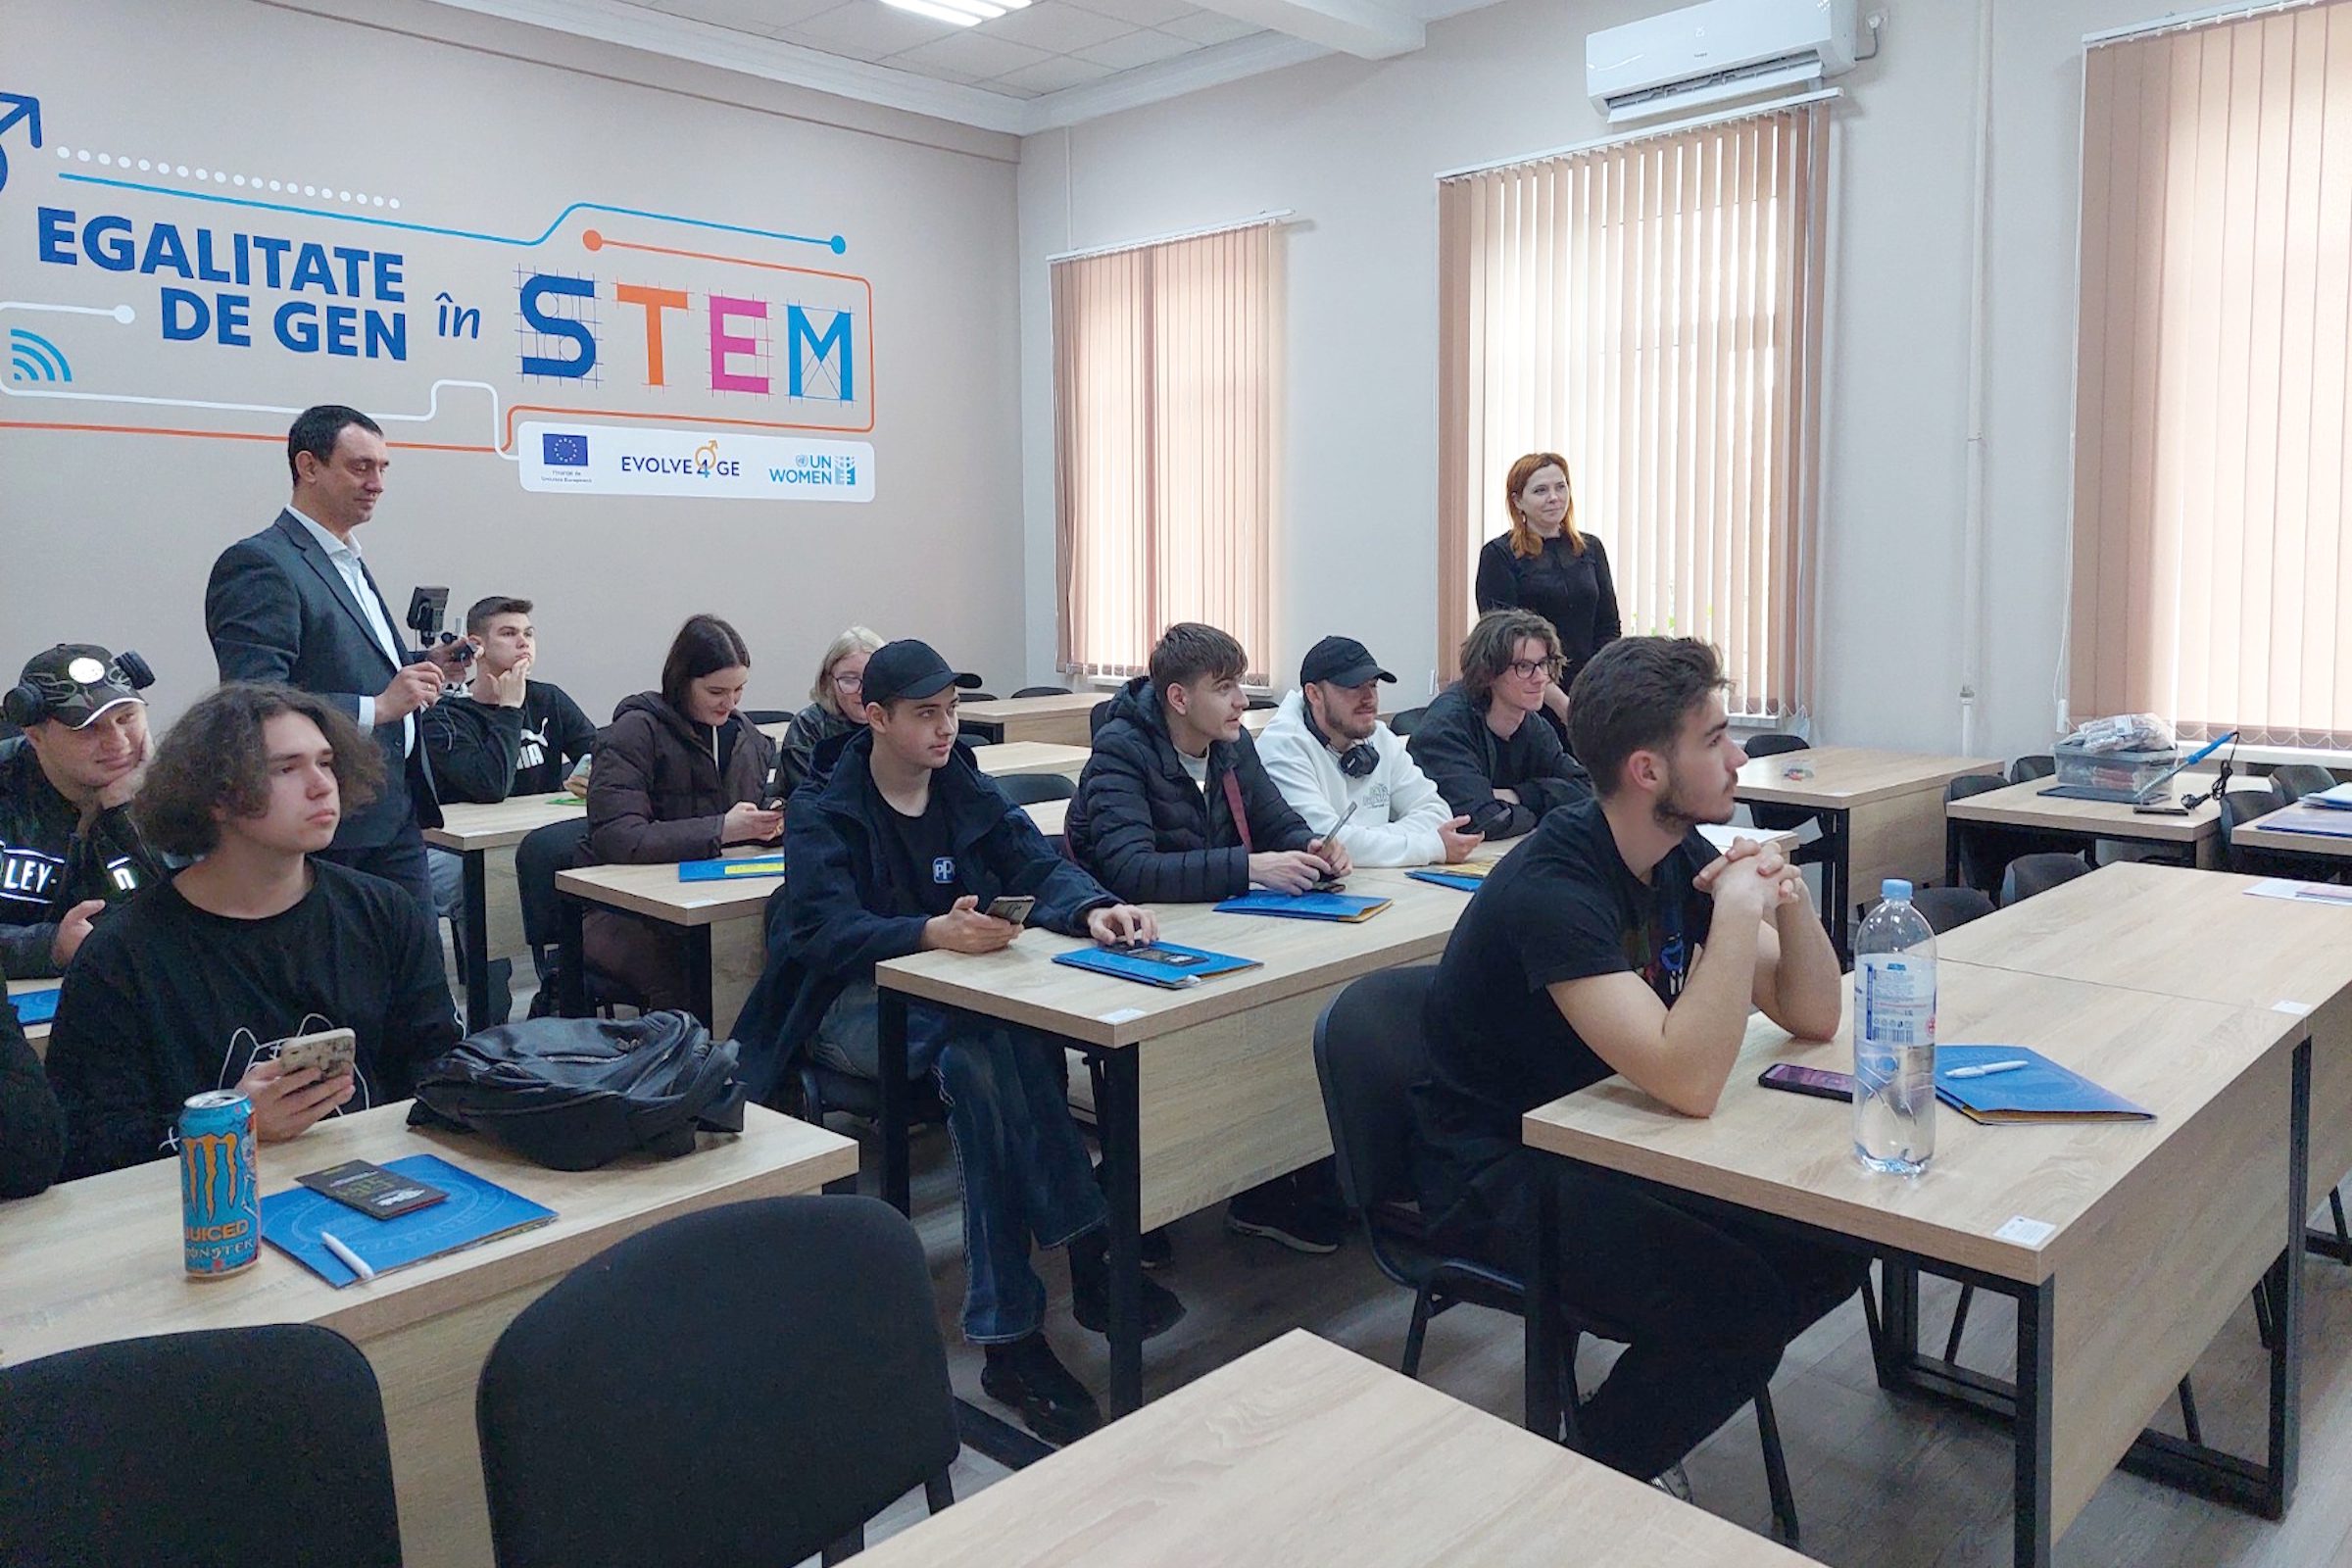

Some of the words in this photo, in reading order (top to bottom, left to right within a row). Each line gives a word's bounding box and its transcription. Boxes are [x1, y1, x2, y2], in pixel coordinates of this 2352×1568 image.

[37, 206, 406, 304] EGALITATE
[160, 286, 252, 348] DE
[272, 301, 408, 362] GEN
[434, 291, 482, 340] în
[518, 273, 855, 402] STEM
[768, 467, 832, 485] WOMEN
[808, 454, 832, 469] UN
